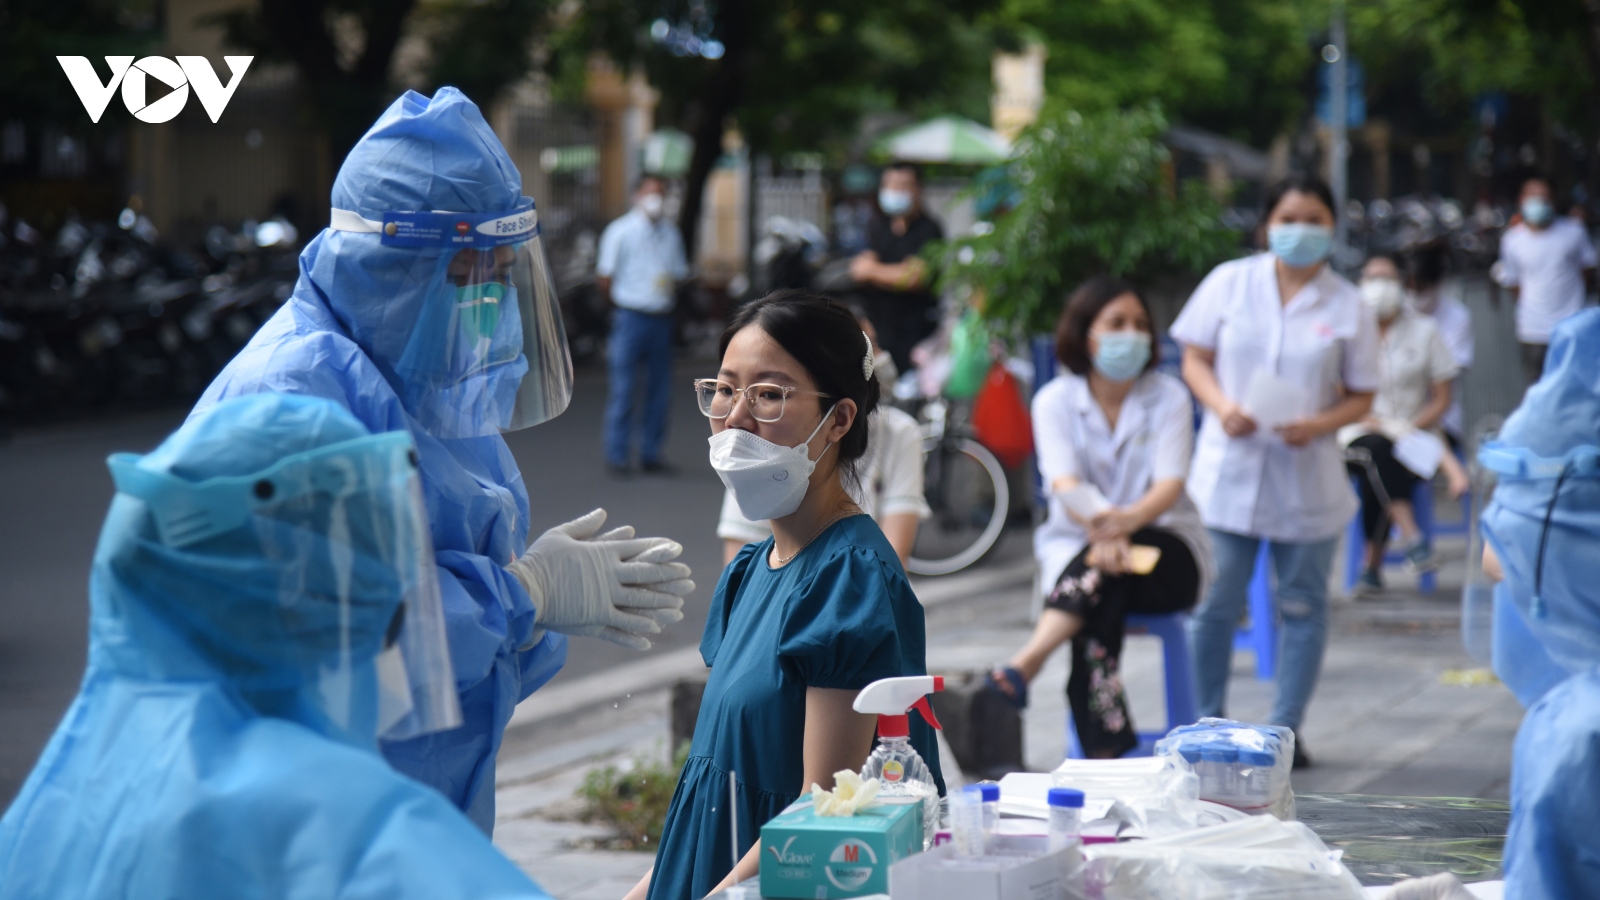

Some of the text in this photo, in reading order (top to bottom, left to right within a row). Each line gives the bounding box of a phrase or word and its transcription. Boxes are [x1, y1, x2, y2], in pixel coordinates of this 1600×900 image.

[496, 220, 517, 233] Face
[844, 845, 859, 862] M
[836, 868, 867, 878] Medium
